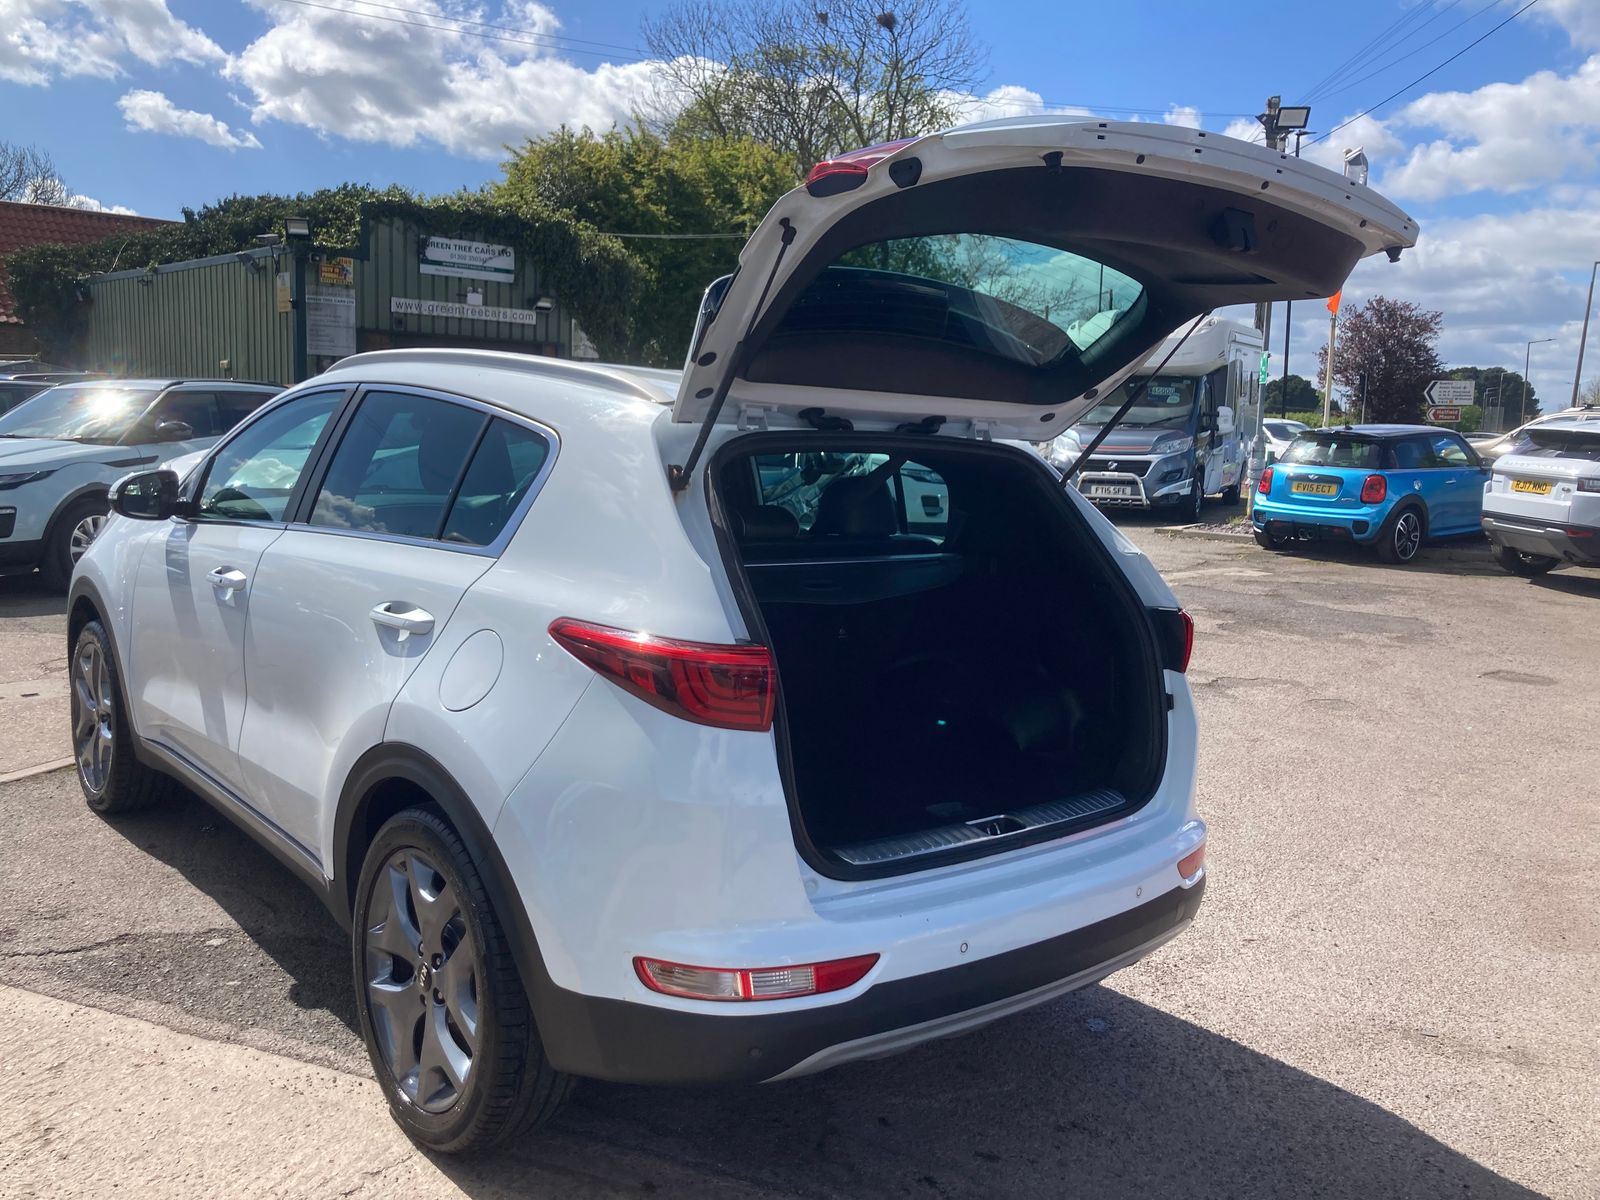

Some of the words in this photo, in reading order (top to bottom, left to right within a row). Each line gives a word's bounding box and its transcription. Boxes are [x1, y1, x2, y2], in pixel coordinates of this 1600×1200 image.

[454, 243, 473, 253] TREE
[475, 246, 496, 256] CARS
[1316, 484, 1333, 494] ECT
